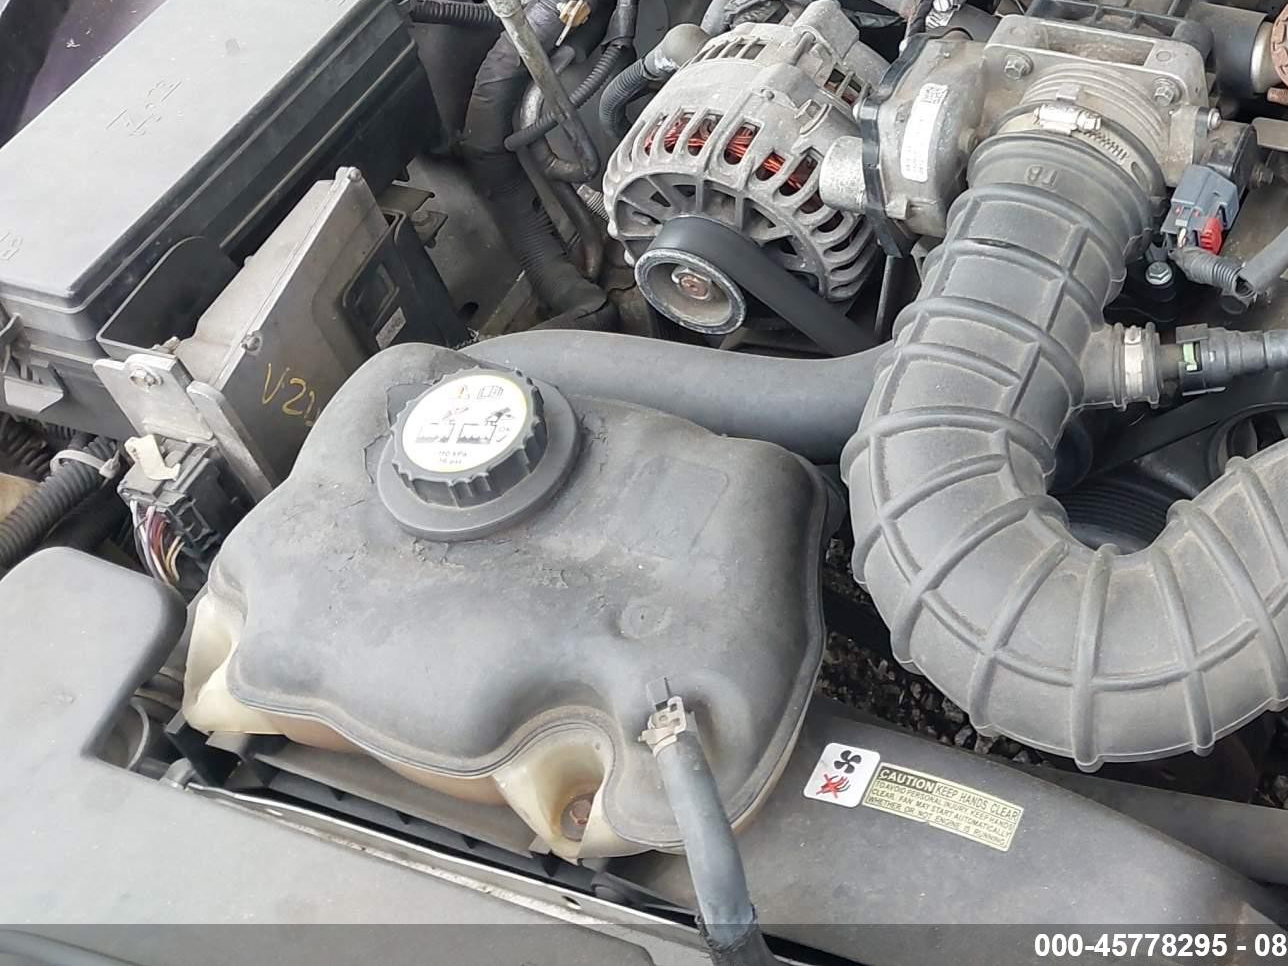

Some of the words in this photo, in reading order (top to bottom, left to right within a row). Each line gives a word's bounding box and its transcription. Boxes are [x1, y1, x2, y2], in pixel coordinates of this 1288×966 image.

[868, 795, 902, 810] WHETHER
[904, 805, 915, 814] OR
[917, 810, 931, 820] NOT
[934, 815, 961, 829] ENGINE
[879, 768, 934, 793] CAUTION
[935, 784, 958, 799] KEEP
[959, 792, 988, 810] HANDS
[989, 803, 1018, 821] CLEAR
[884, 782, 907, 795] AVOID
[906, 789, 943, 806] PERSONAL
[970, 808, 989, 821] KEEP
[989, 815, 1013, 830] HANDS
[898, 794, 913, 805] FAN
[916, 800, 930, 810] MAY
[931, 805, 954, 818] START
[954, 813, 1012, 838] AUTOMATICALLY
